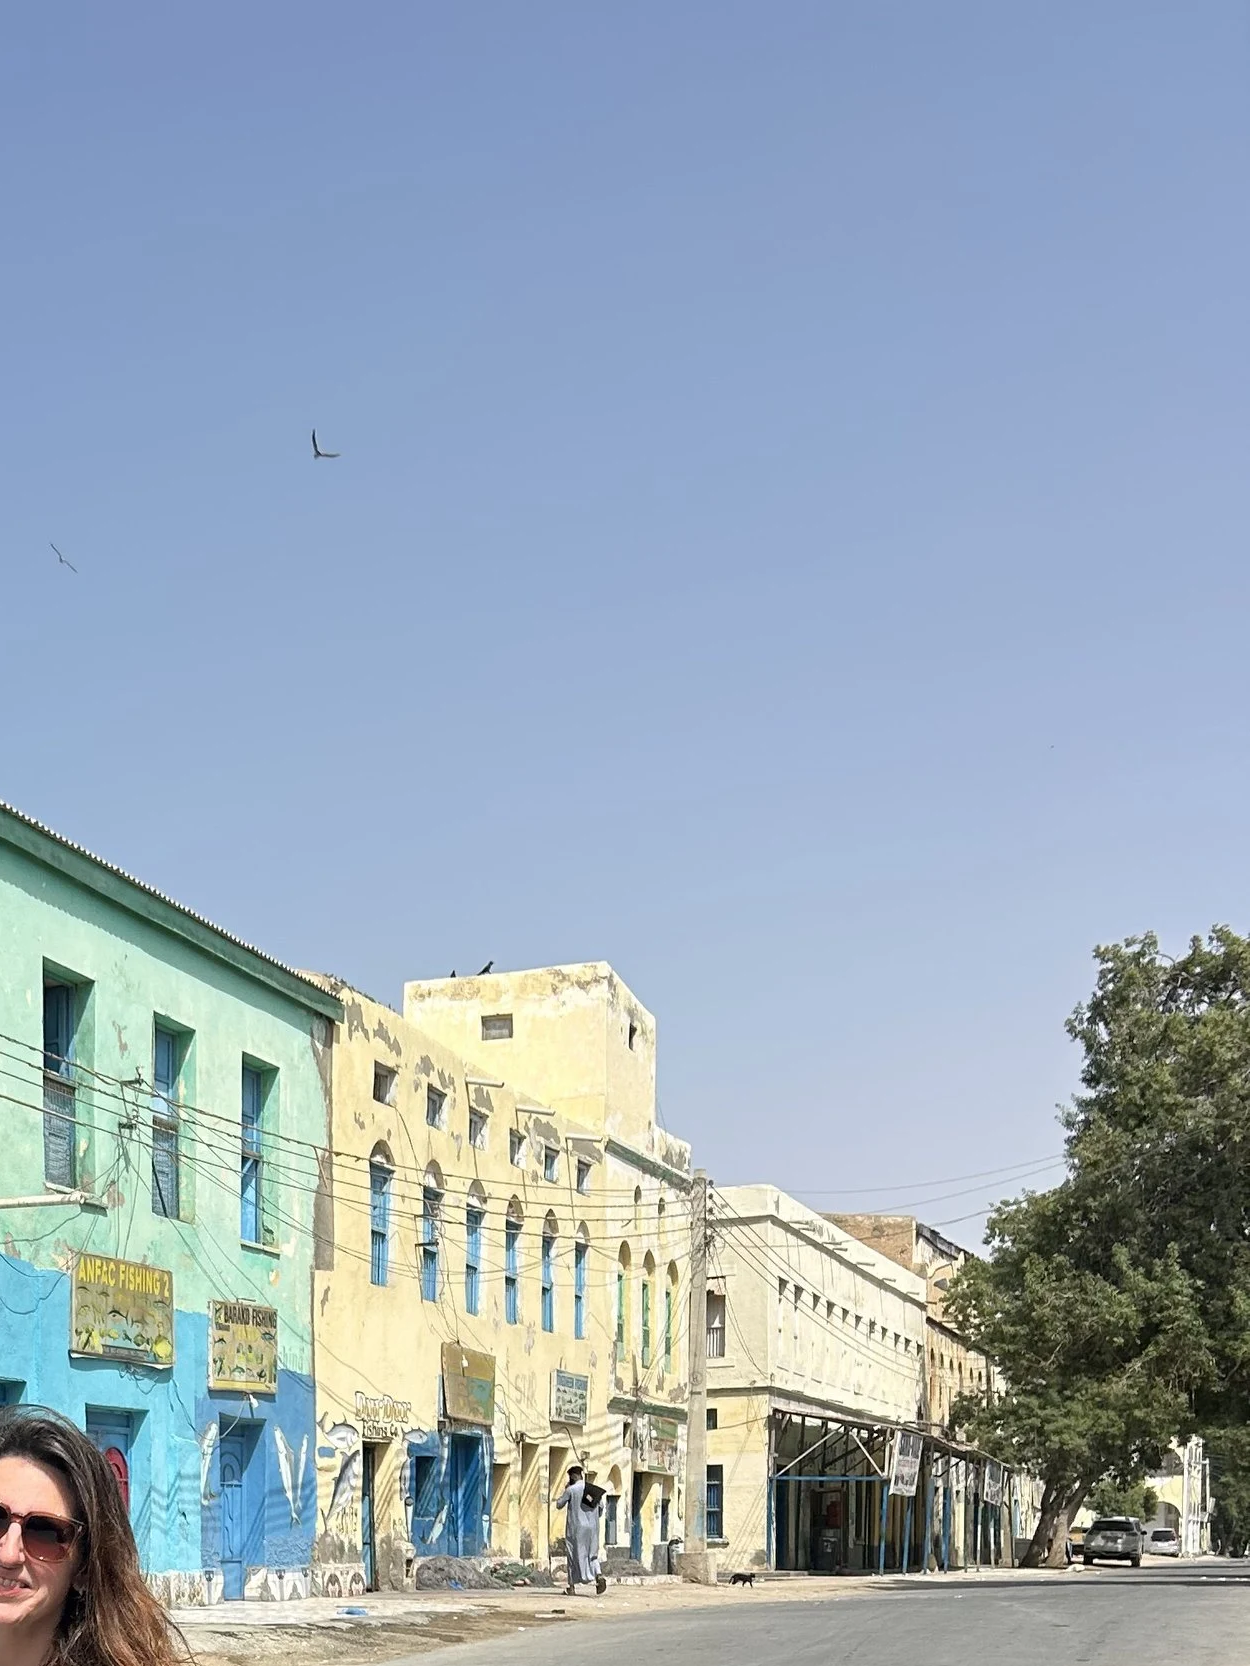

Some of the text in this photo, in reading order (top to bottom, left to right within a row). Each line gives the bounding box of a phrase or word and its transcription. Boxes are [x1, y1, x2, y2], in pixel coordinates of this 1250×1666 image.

[119, 1264, 161, 1296] FISHING
[163, 1275, 170, 1298] 2
[252, 1308, 277, 1330] FISHING
